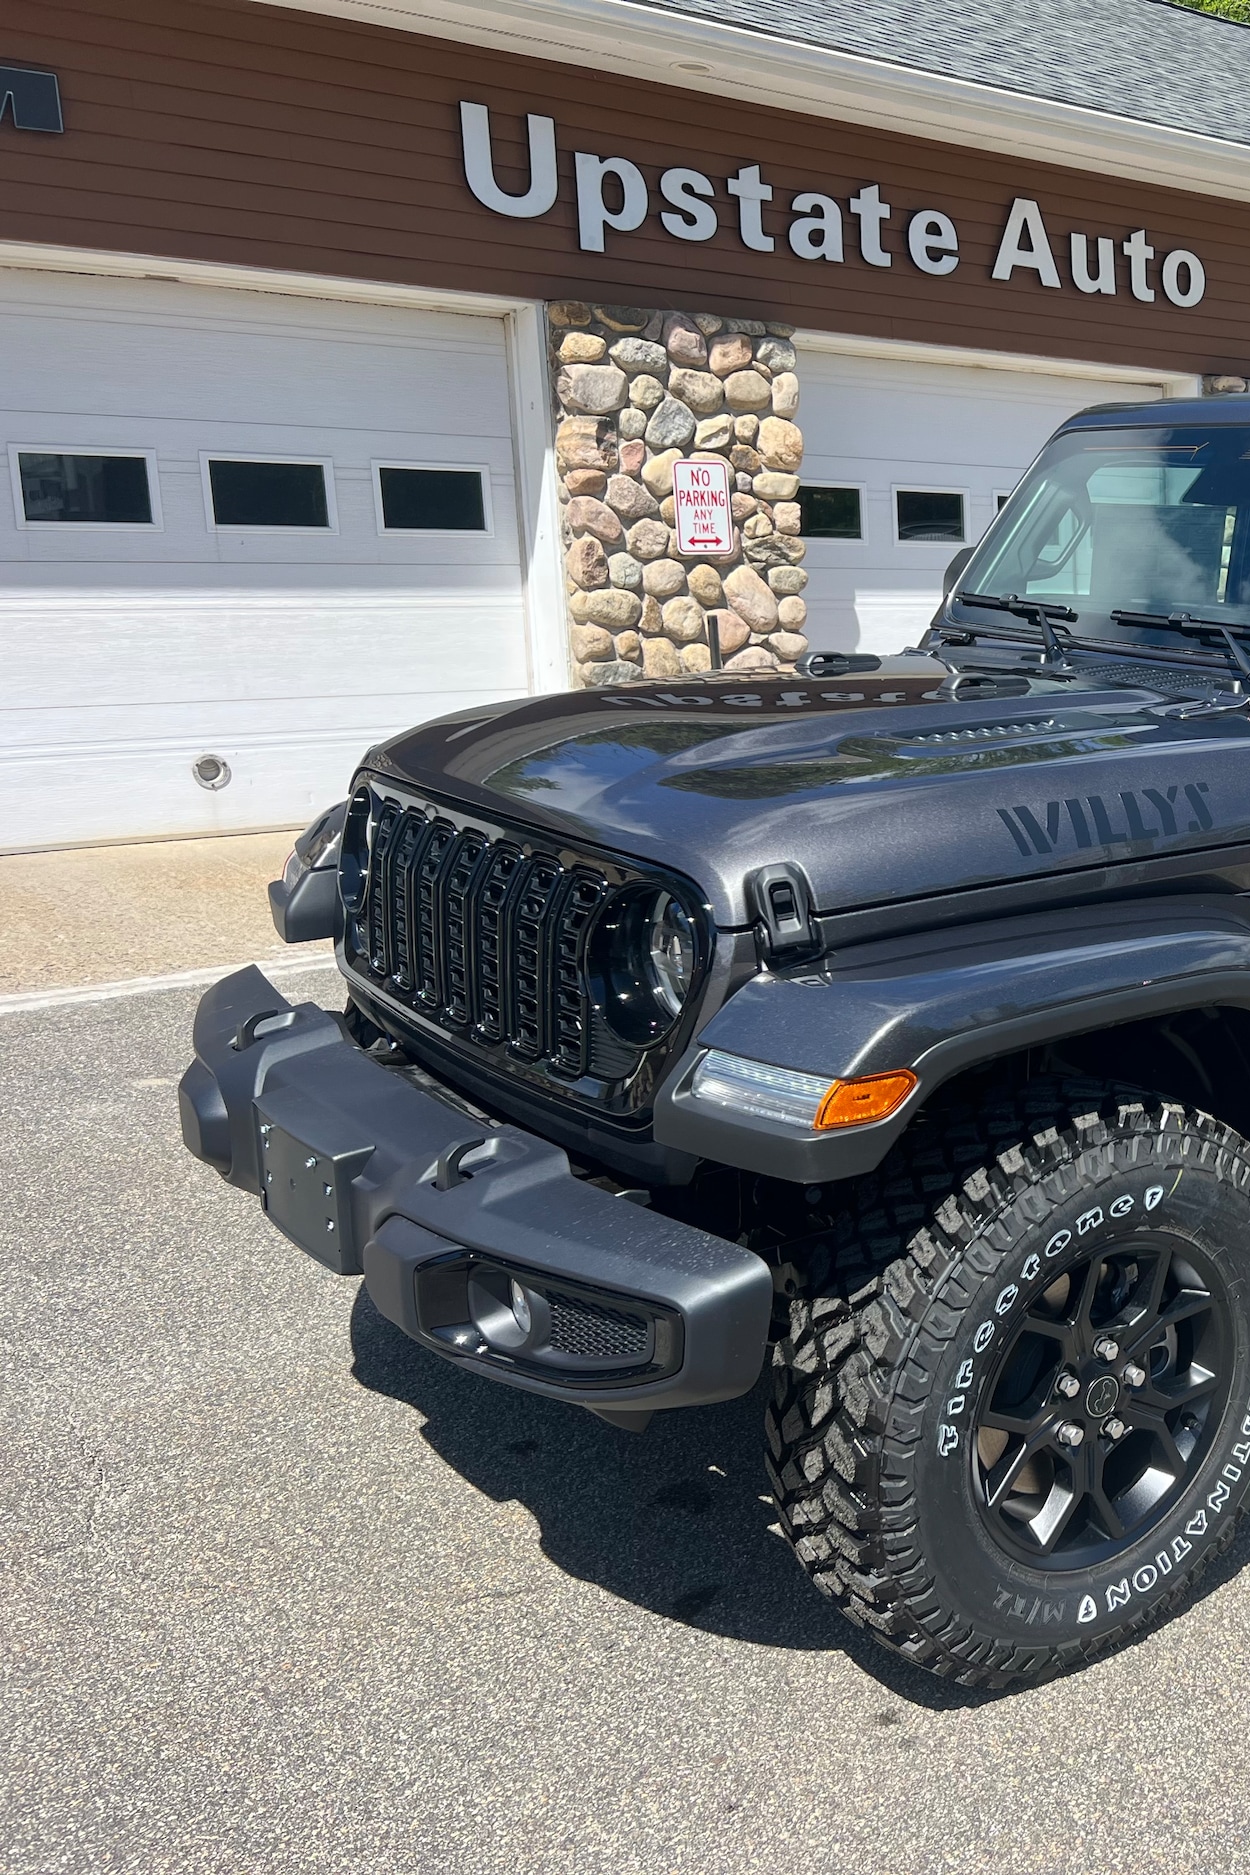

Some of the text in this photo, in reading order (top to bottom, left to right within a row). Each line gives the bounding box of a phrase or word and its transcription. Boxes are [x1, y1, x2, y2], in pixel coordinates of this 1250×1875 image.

[459, 100, 1207, 309] Upstate Auto
[690, 469, 711, 487] NO
[678, 490, 726, 508] PARKING
[693, 509, 713, 520] ANY
[693, 522, 716, 534] TIME
[996, 782, 1213, 857] WILLYS
